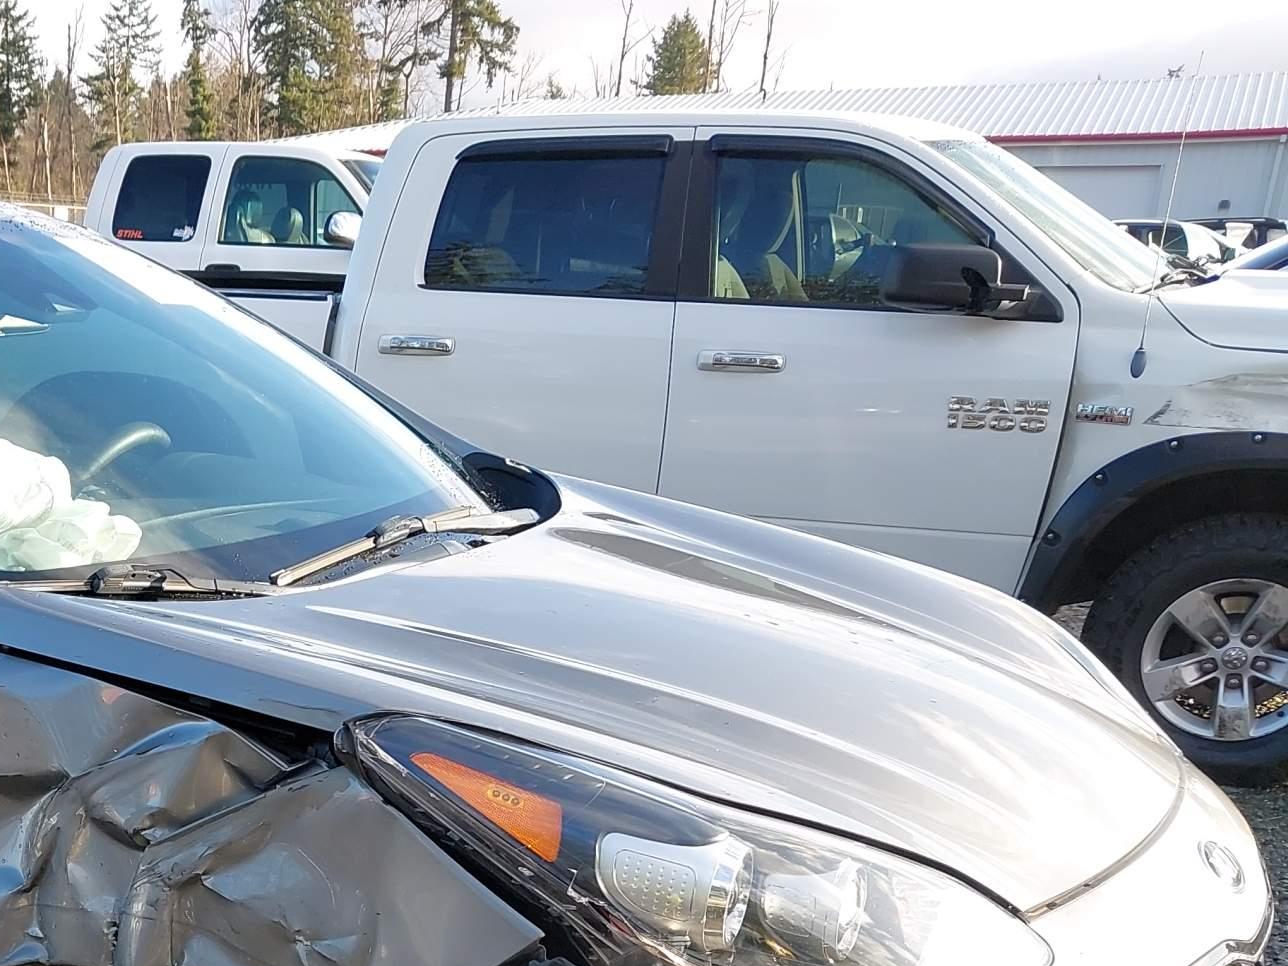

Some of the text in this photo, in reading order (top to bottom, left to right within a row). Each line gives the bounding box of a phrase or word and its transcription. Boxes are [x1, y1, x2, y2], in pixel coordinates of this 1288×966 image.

[116, 229, 143, 239] STIHL
[948, 396, 1050, 415] RAM
[1077, 403, 1134, 418] HEMI
[947, 413, 1047, 433] 1500
